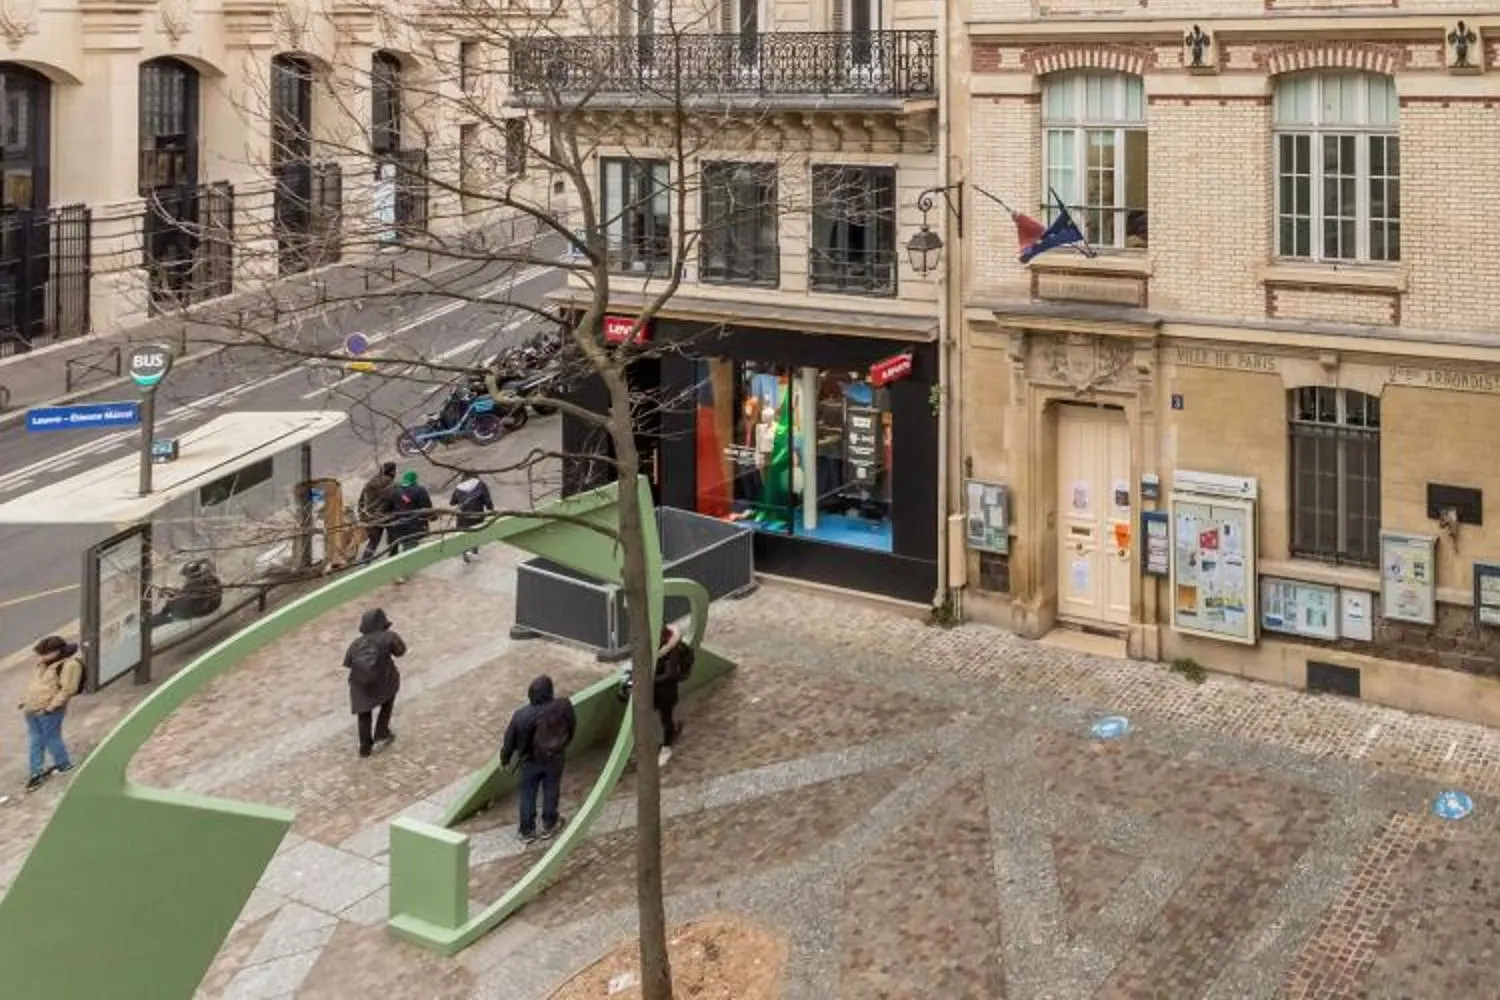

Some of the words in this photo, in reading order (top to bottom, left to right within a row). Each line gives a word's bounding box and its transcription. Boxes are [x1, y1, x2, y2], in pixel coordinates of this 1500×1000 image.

[132, 353, 163, 368] BUS
[1177, 343, 1209, 364] VILLE
[1215, 350, 1234, 368] DE
[1238, 351, 1277, 370] PARIS
[32, 415, 61, 425] Louvre
[104, 409, 133, 419] Marcel
